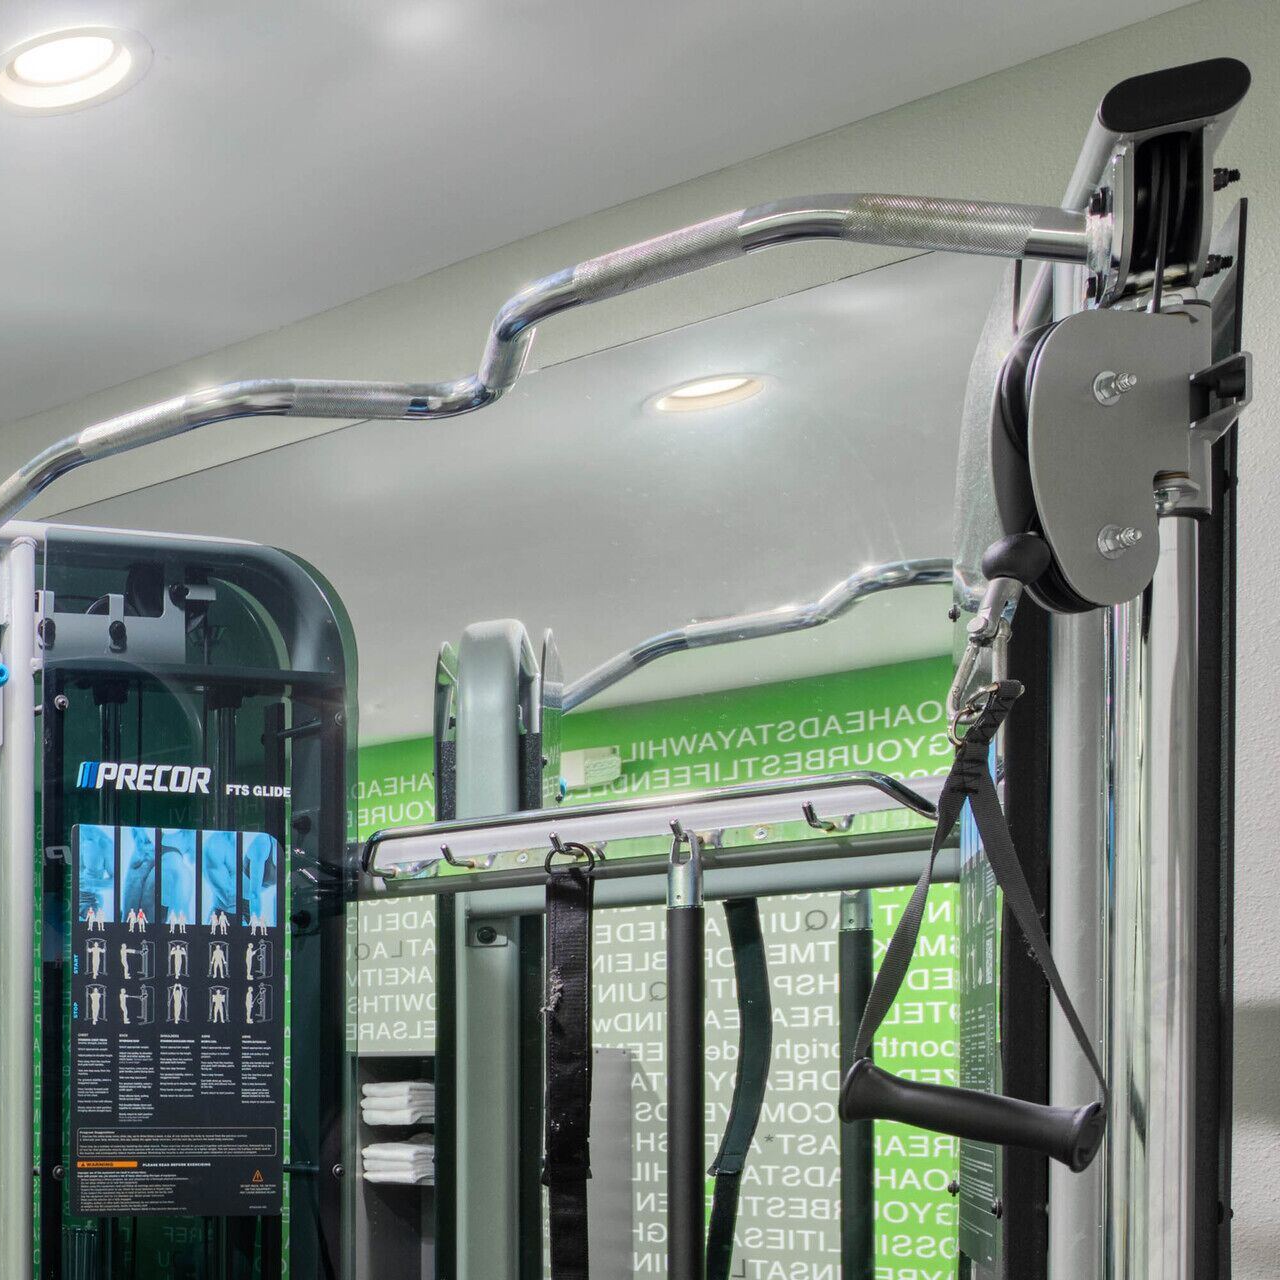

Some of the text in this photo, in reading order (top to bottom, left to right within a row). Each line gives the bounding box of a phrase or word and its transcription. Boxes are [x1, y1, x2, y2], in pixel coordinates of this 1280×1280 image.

[95, 761, 212, 795] PRECOR
[225, 784, 291, 798] FTS GLIDE
